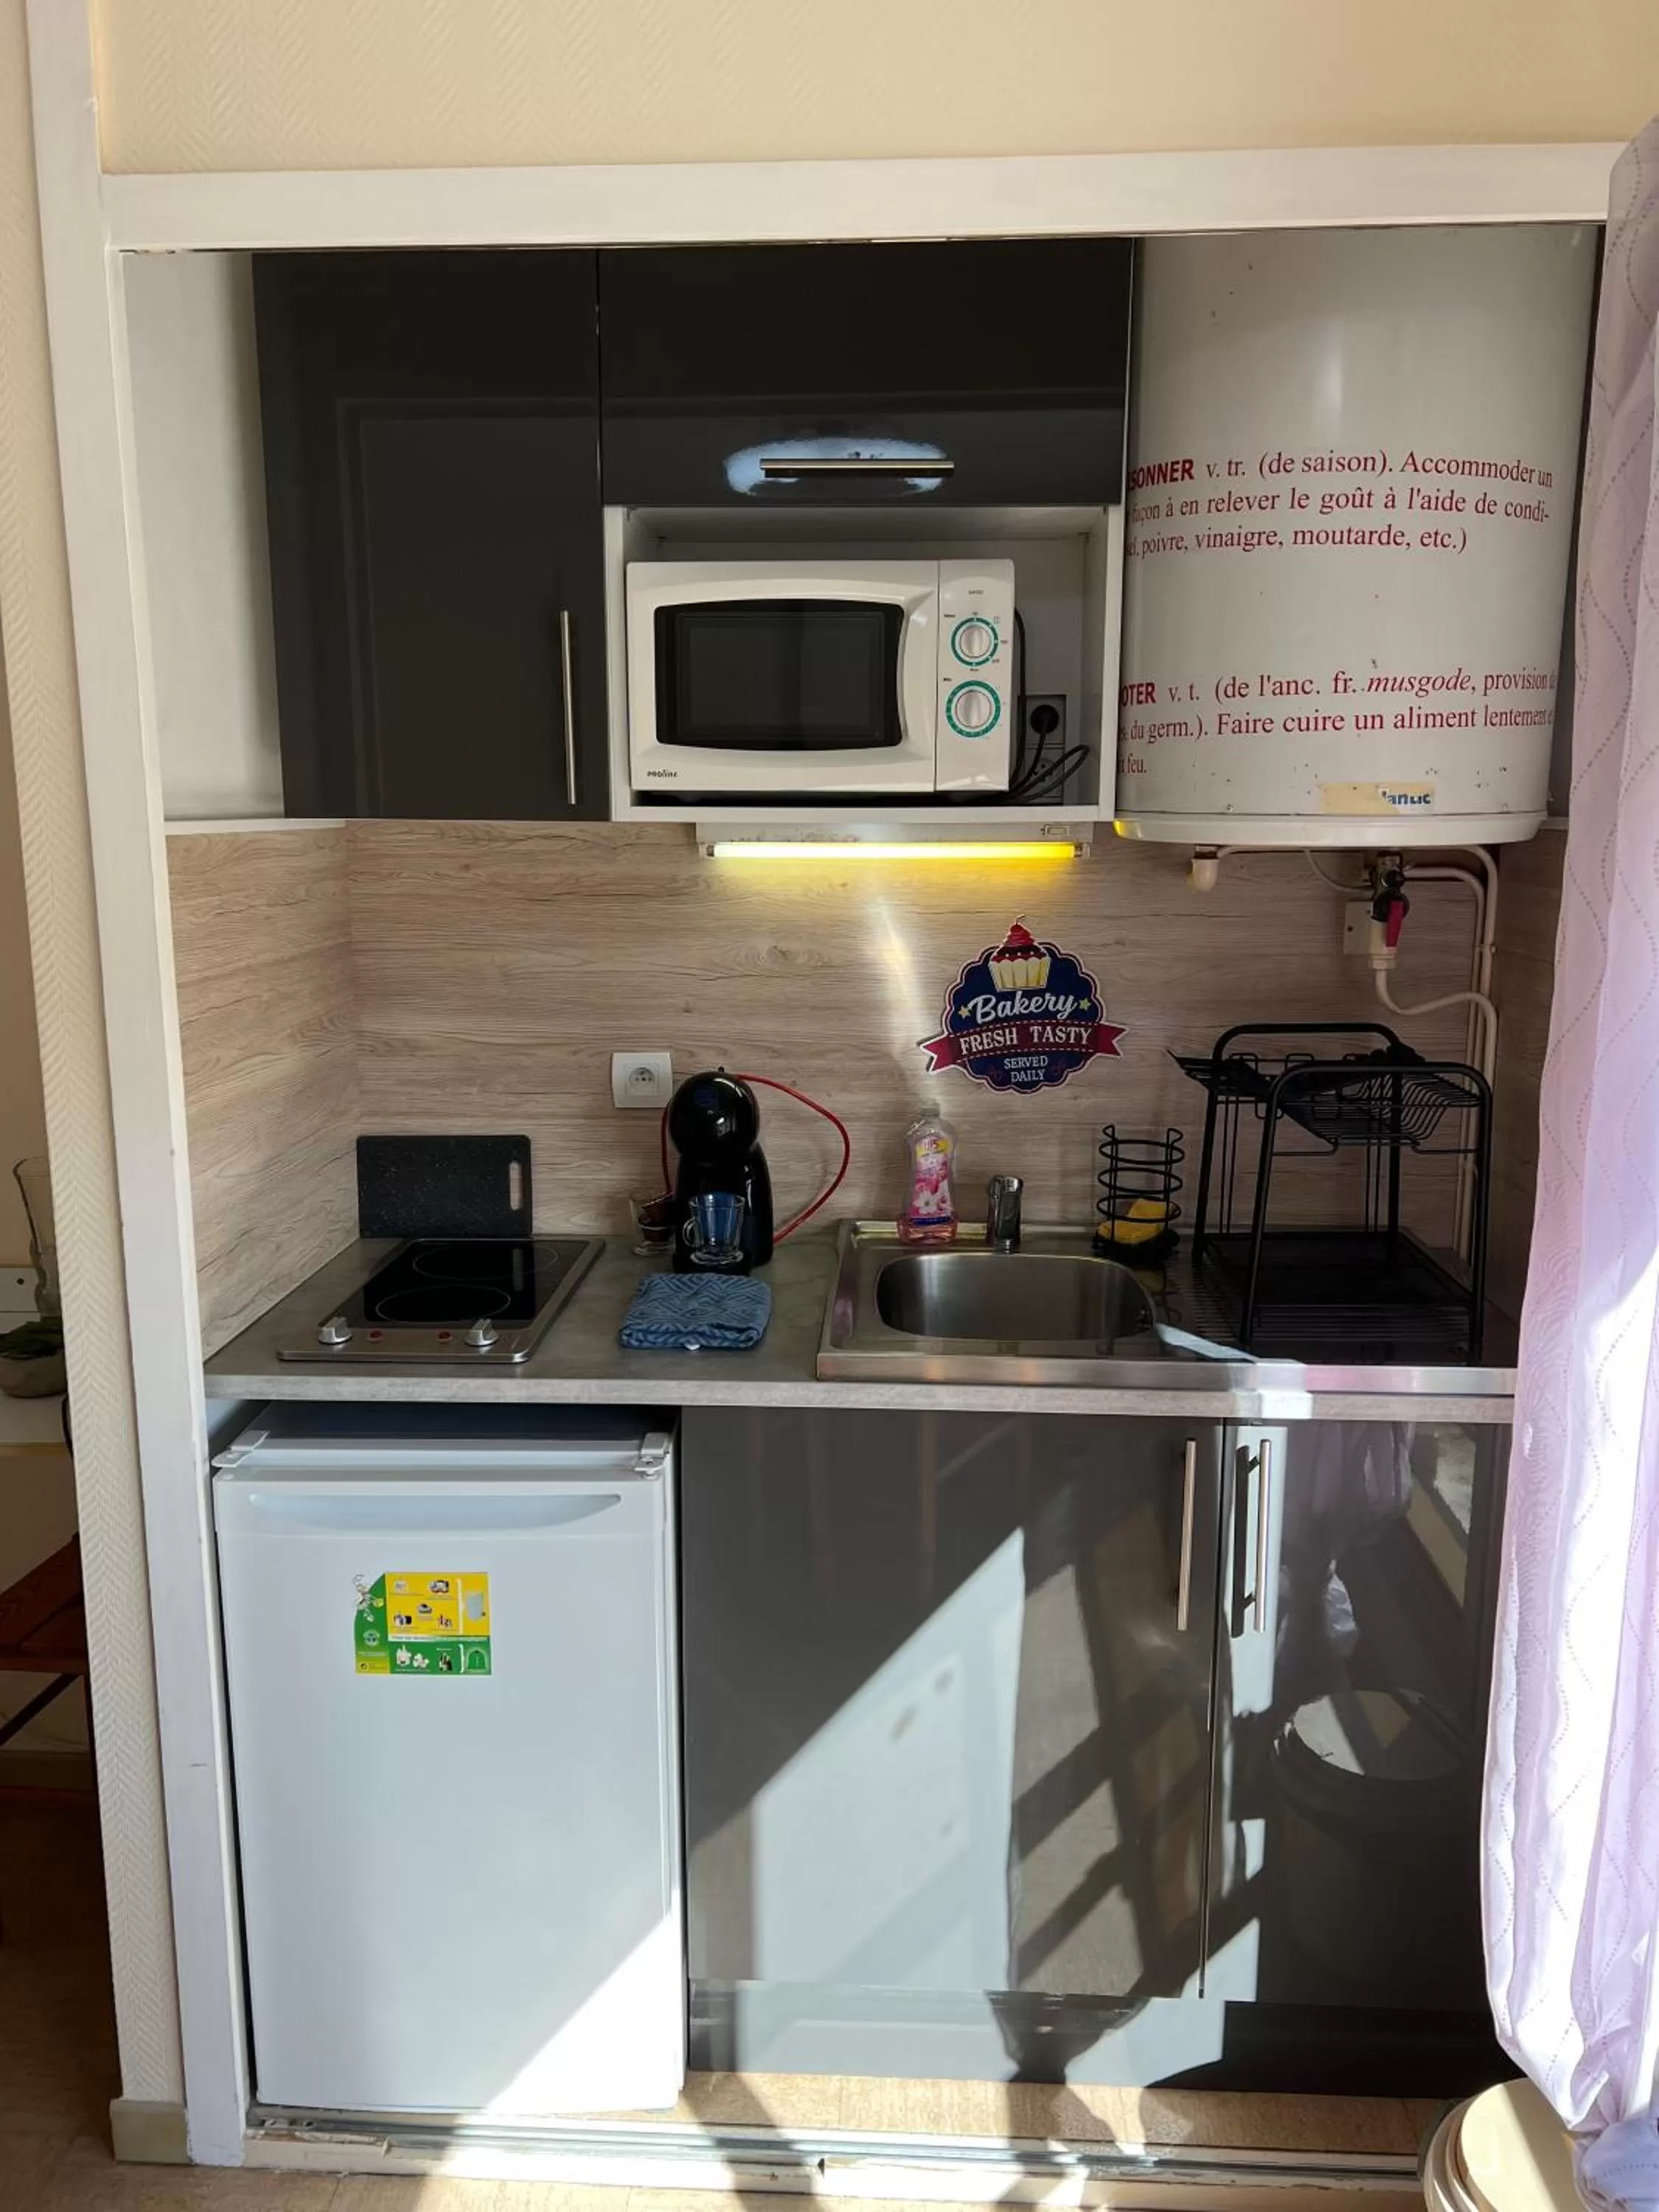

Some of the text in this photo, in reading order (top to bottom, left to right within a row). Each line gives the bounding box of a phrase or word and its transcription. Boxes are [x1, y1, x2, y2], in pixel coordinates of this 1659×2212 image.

[1206, 462, 1220, 479] v.
[1228, 458, 1245, 477] tr.
[1259, 451, 1295, 479] (de
[1301, 449, 1393, 479] saison).
[1399, 451, 1535, 484] Accommoder
[1538, 469, 1552, 487] un
[1180, 499, 1198, 516] en
[1207, 490, 1280, 514] relever
[1289, 487, 1310, 509] le
[1319, 487, 1374, 515] goût
[1384, 487, 1397, 509] à
[1408, 487, 1466, 512] l'aide
[1475, 492, 1498, 515] de
[1504, 500, 1549, 522] condi-
[1143, 532, 1188, 559] poivre,
[1194, 525, 1284, 552] vinaigre,
[1292, 524, 1411, 550] moutarde,
[1419, 527, 1467, 554] etc.)
[1169, 686, 1181, 701] v.
[1189, 682, 1200, 700] t.
[1215, 676, 1250, 705] (de
[1259, 674, 1320, 696] l'anc.
[1367, 667, 1476, 698] musgode,
[1482, 667, 1547, 696] provision
[1130, 720, 1144, 740] du
[1148, 714, 1208, 744] germ.).
[1217, 712, 1274, 735] Faire
[1283, 709, 1345, 732] cuire
[1354, 714, 1384, 730] un
[1394, 706, 1478, 728] aliment
[1484, 704, 1547, 727] lentement
[967, 990, 1077, 1023] Bakery
[959, 1026, 1093, 1055] FRESH TASTY
[1004, 1055, 1048, 1070] SERVED
[1011, 1069, 1046, 1082] DAILY
